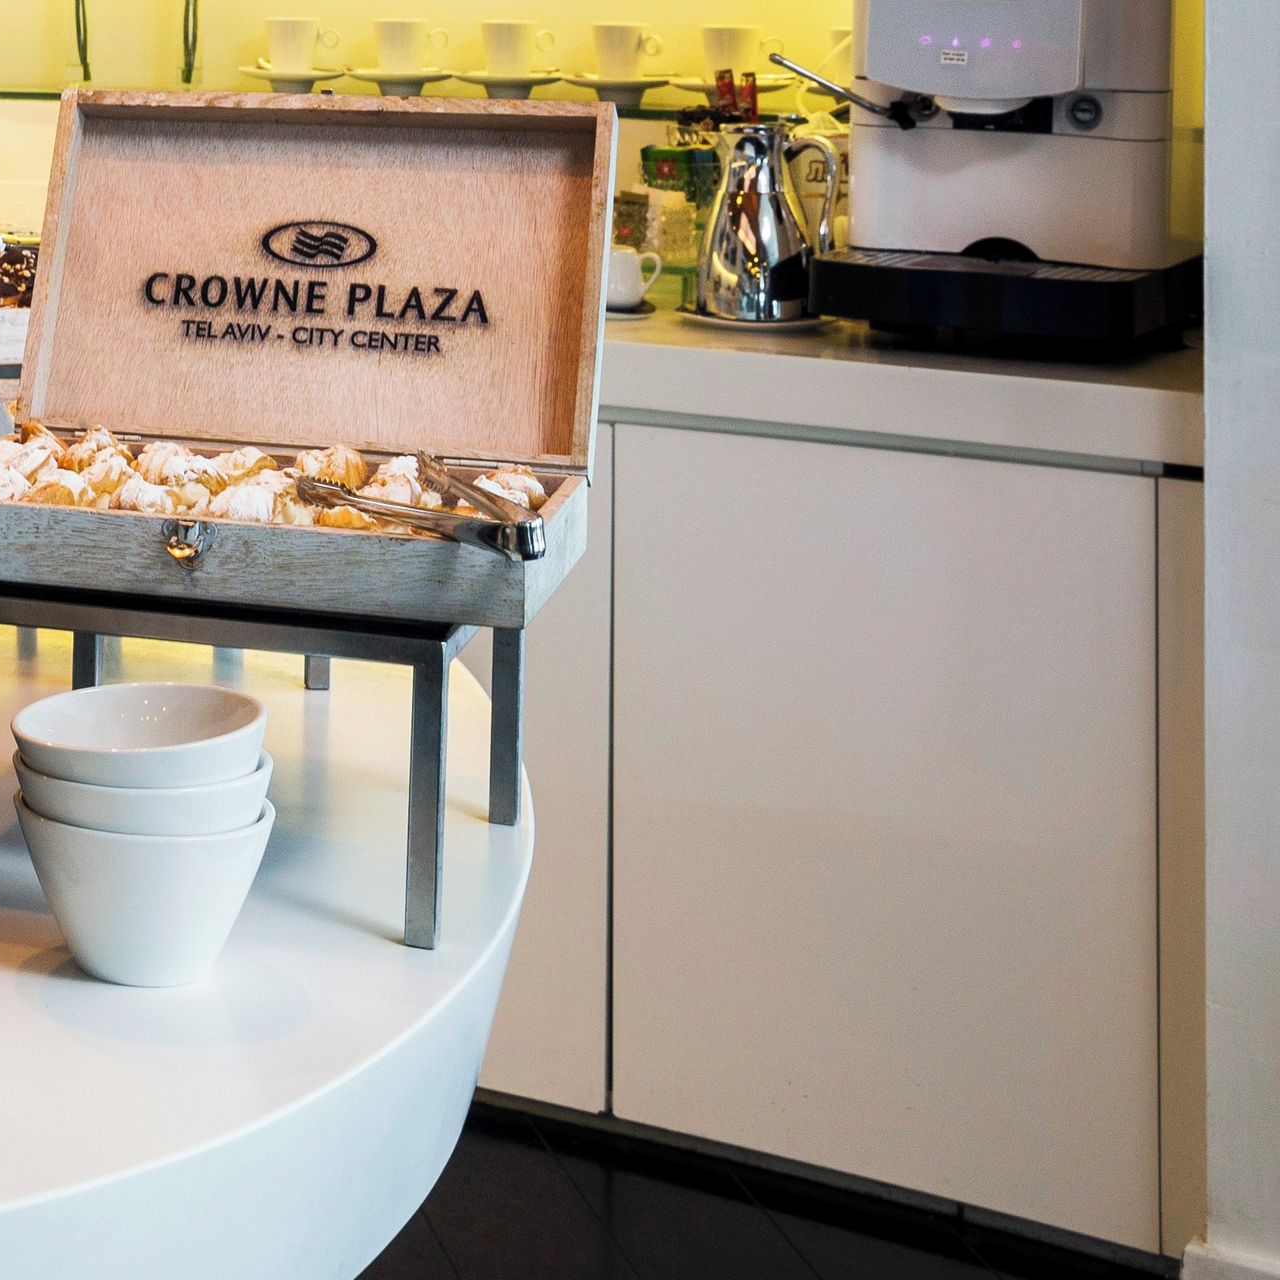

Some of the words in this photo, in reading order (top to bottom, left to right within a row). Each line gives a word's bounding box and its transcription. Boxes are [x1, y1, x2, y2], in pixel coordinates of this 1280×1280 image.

[144, 272, 328, 315] CROWNE
[347, 283, 490, 324] PLAZA
[181, 320, 217, 339] TEL
[220, 323, 272, 342] AVIV
[292, 327, 341, 347] CITY
[350, 332, 441, 354] CENTER
